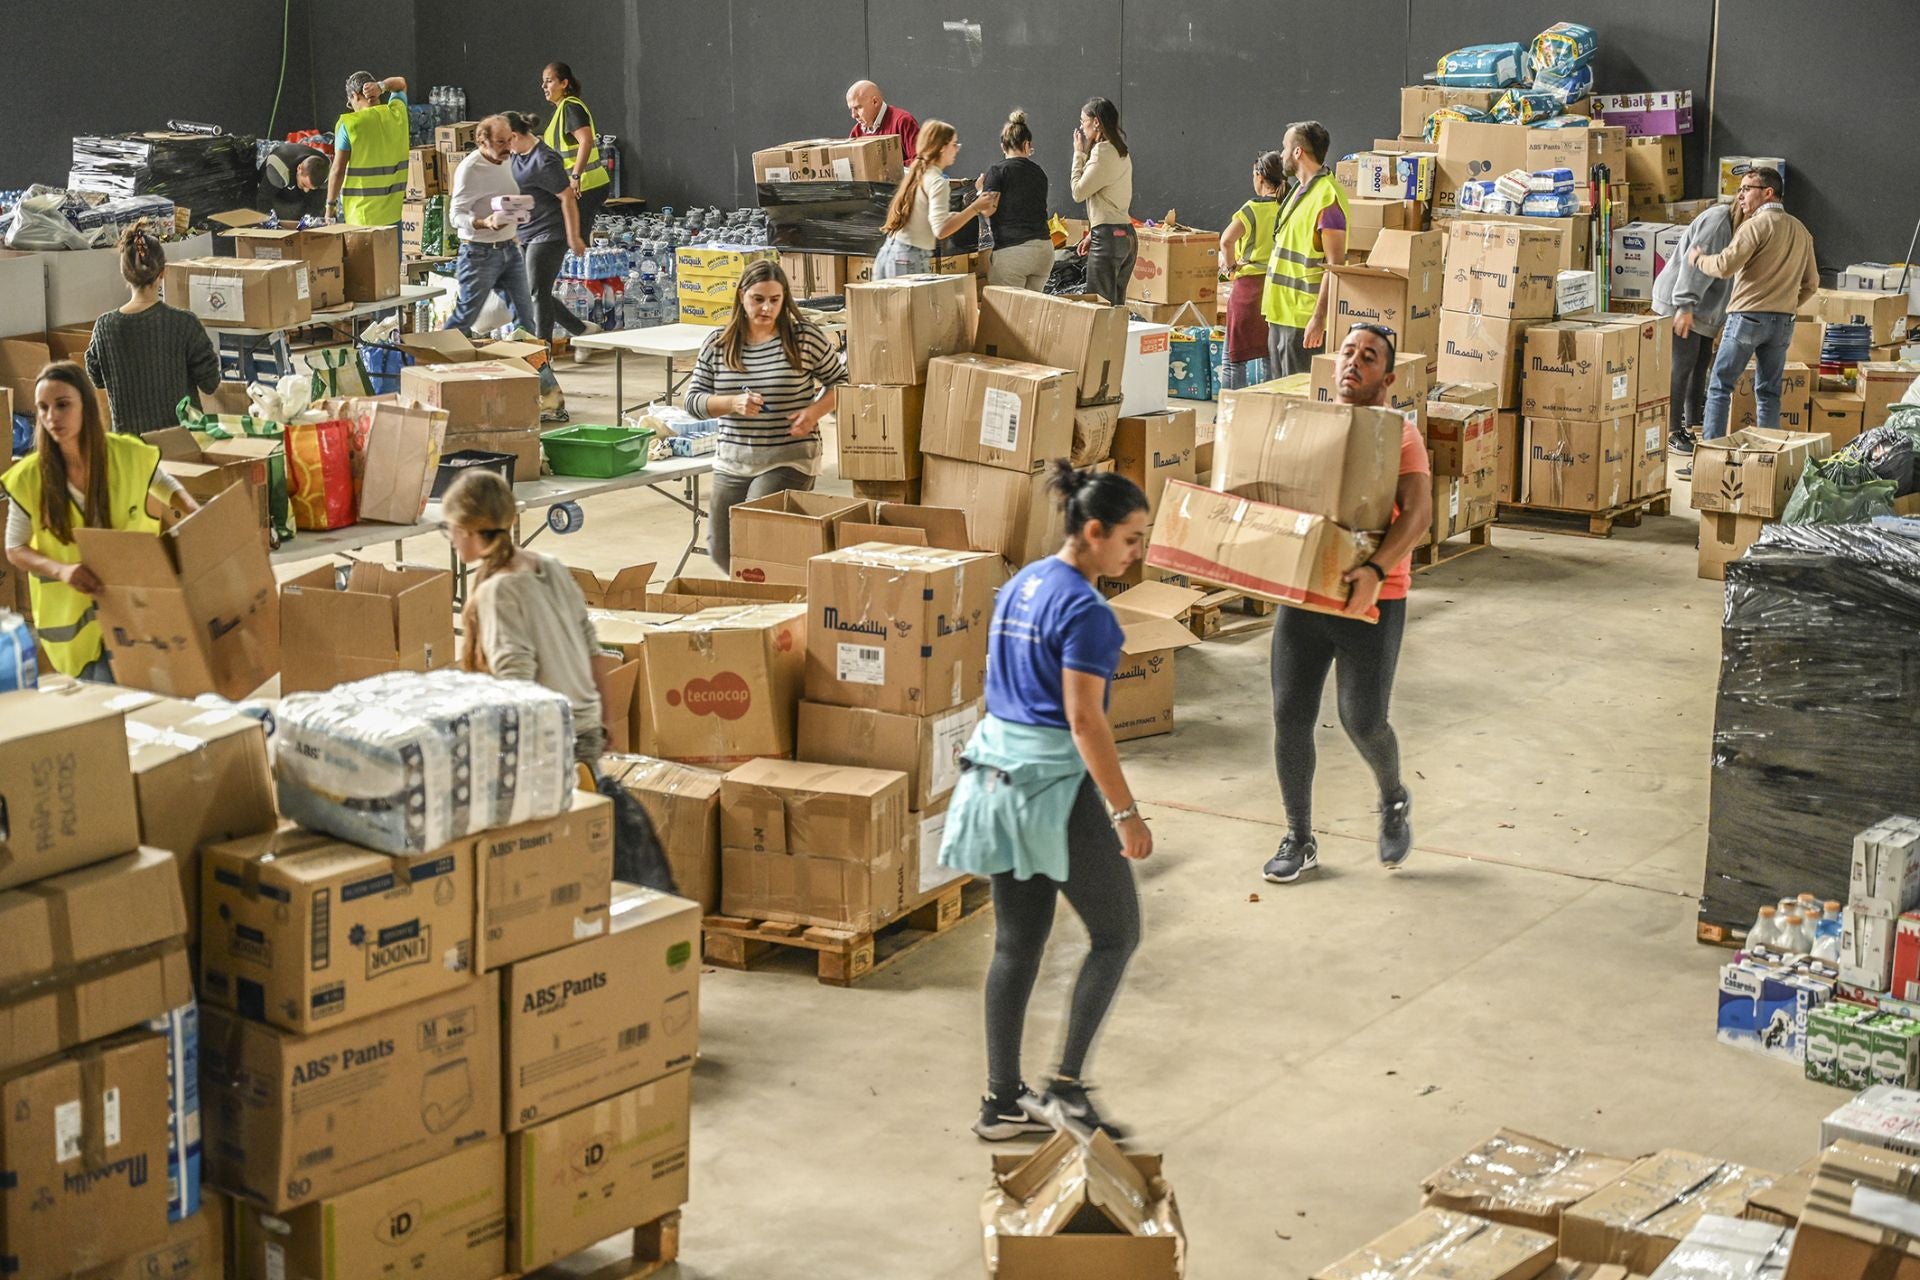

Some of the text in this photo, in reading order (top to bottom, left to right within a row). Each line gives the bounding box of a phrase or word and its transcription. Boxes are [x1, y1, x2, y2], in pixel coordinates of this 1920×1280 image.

[1612, 97, 1655, 109] Paales
[679, 255, 702, 267] Nesquik
[680, 279, 701, 291] Nesquik
[1470, 266, 1507, 288] Massilly
[682, 305, 706, 316] Nesquik
[1339, 300, 1380, 321] Massilly
[1446, 340, 1483, 362] Massilly
[1532, 356, 1574, 376] Massilly
[824, 607, 887, 641] Massilly
[1111, 665, 1146, 680] assilly
[688, 689, 749, 703] tecnocap
[1114, 721, 1129, 729] MADE
[1135, 716, 1156, 726] FRANCE
[371, 937, 426, 970] LINDOR
[1729, 970, 1737, 980] La
[522, 971, 607, 1013] ABS Pants
[291, 1039, 395, 1086] ABS Pants
[585, 1143, 604, 1168] iD
[64, 1153, 148, 1197] Massilly
[286, 1178, 312, 1200] 80
[390, 1212, 411, 1239] iD
